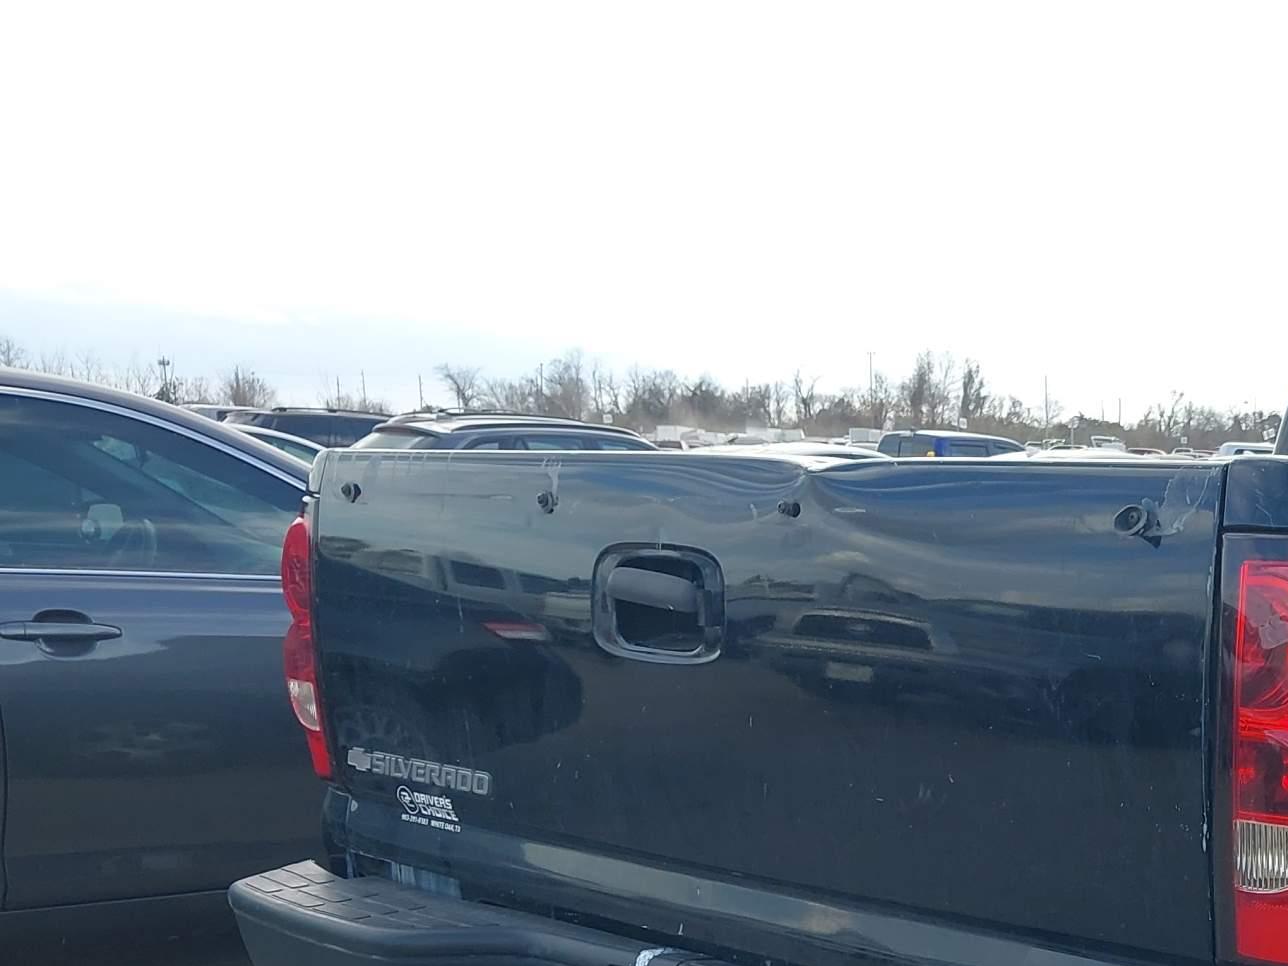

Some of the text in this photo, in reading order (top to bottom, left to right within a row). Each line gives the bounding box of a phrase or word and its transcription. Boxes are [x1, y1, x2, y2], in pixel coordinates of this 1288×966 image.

[371, 752, 491, 795] SILVERADO
[413, 792, 453, 809] DRIVER'S
[419, 804, 459, 821] CHOICE
